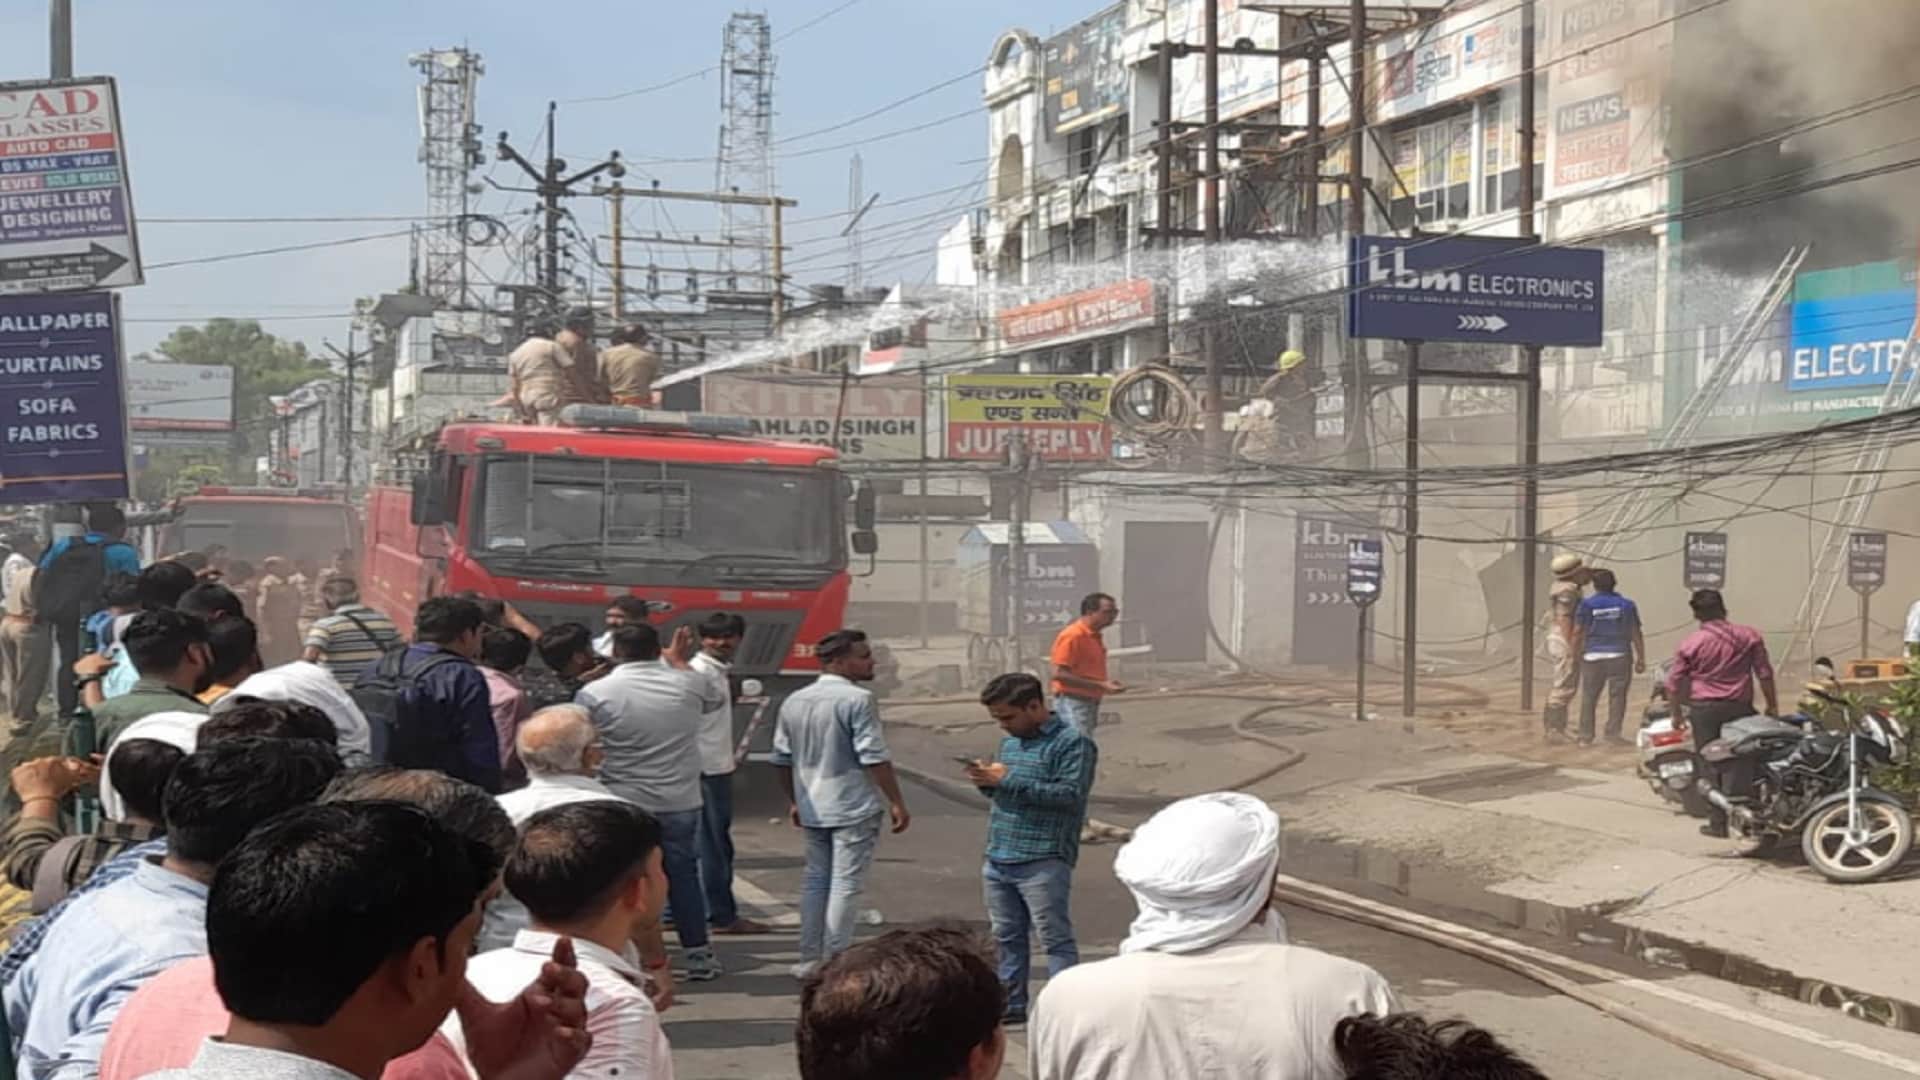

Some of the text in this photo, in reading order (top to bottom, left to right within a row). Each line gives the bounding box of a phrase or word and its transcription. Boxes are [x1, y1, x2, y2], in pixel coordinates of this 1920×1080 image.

[1559, 96, 1620, 132] NEWS
[0, 117, 104, 137] LASSES
[6, 138, 90, 155] AUTO CAD
[26, 157, 57, 170] MAX
[0, 175, 38, 191] EVIT
[0, 189, 113, 211] JEWELLERY
[3, 206, 113, 229] DESIGNING
[1468, 272, 1595, 300] ELECTRONICS
[0, 312, 110, 332] ALLPAPER
[18, 398, 77, 416] SOFA
[7, 424, 99, 443] FABRICS
[748, 419, 916, 435] AHLAD SINGH
[1026, 552, 1076, 578] bm
